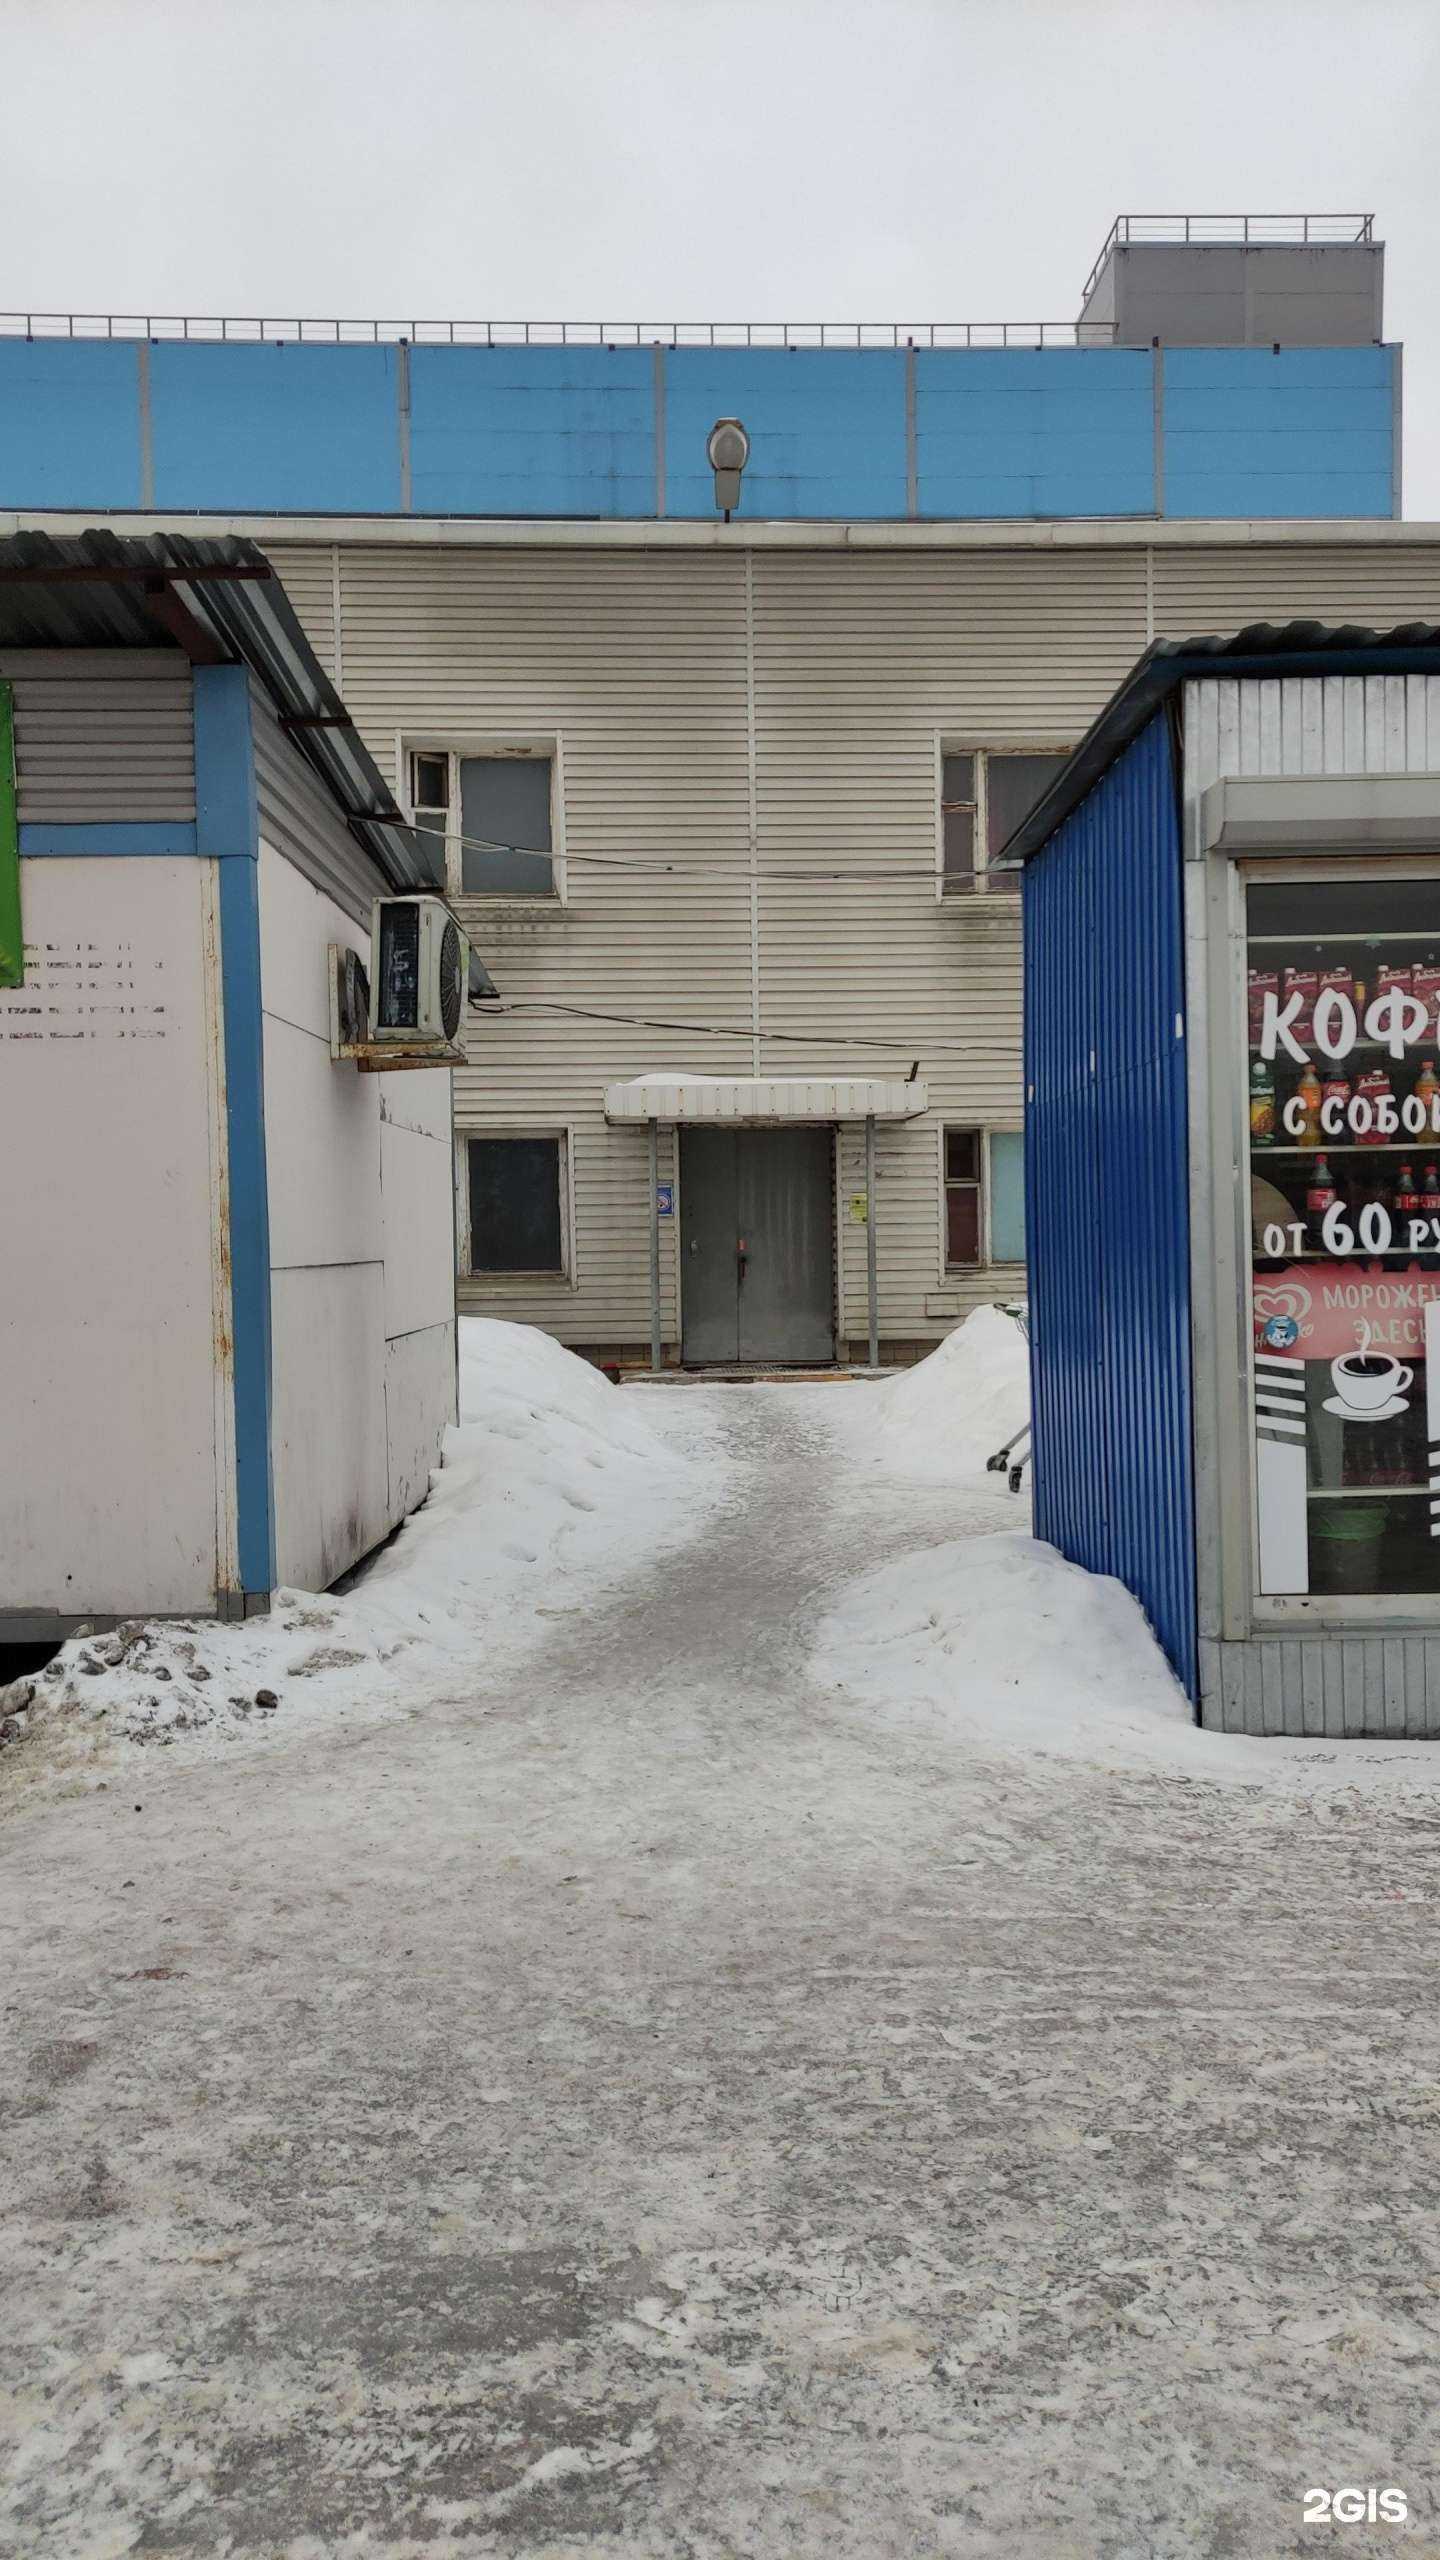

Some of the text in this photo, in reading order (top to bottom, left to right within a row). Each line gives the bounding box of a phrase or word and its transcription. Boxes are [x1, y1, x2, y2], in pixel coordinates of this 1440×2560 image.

[1260, 985, 1440, 1065] КОФ
[1282, 1095, 1308, 1136] С
[1263, 1223, 1308, 1258] ОТ
[1322, 1200, 1392, 1256] 60
